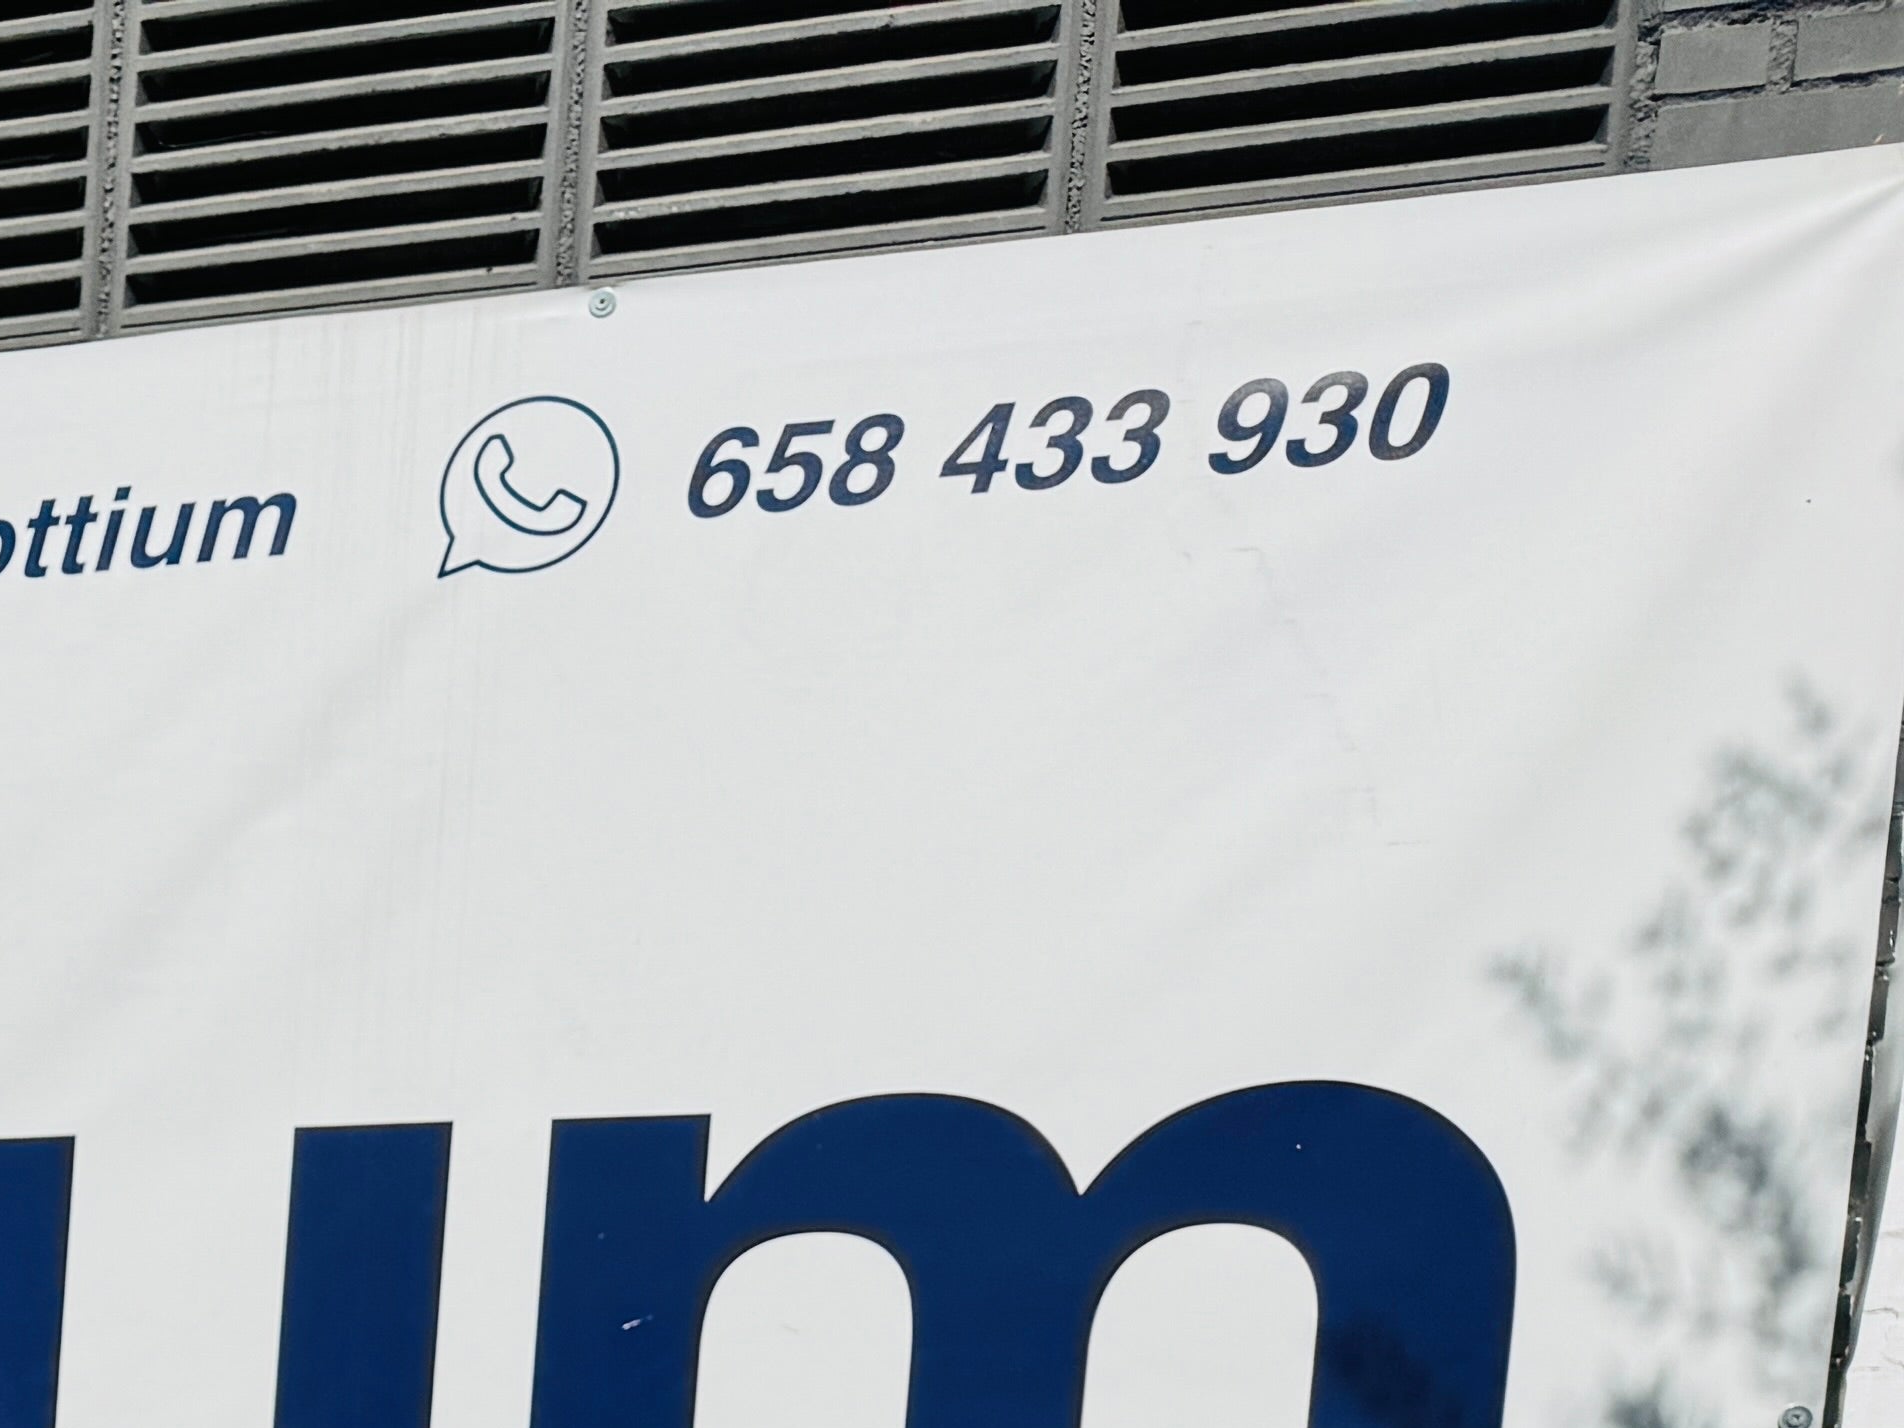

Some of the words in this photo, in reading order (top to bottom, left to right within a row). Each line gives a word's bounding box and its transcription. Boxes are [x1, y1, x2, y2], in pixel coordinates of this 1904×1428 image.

[687, 410, 906, 519] 658
[939, 388, 1172, 494] 433
[1208, 362, 1451, 475] 930
